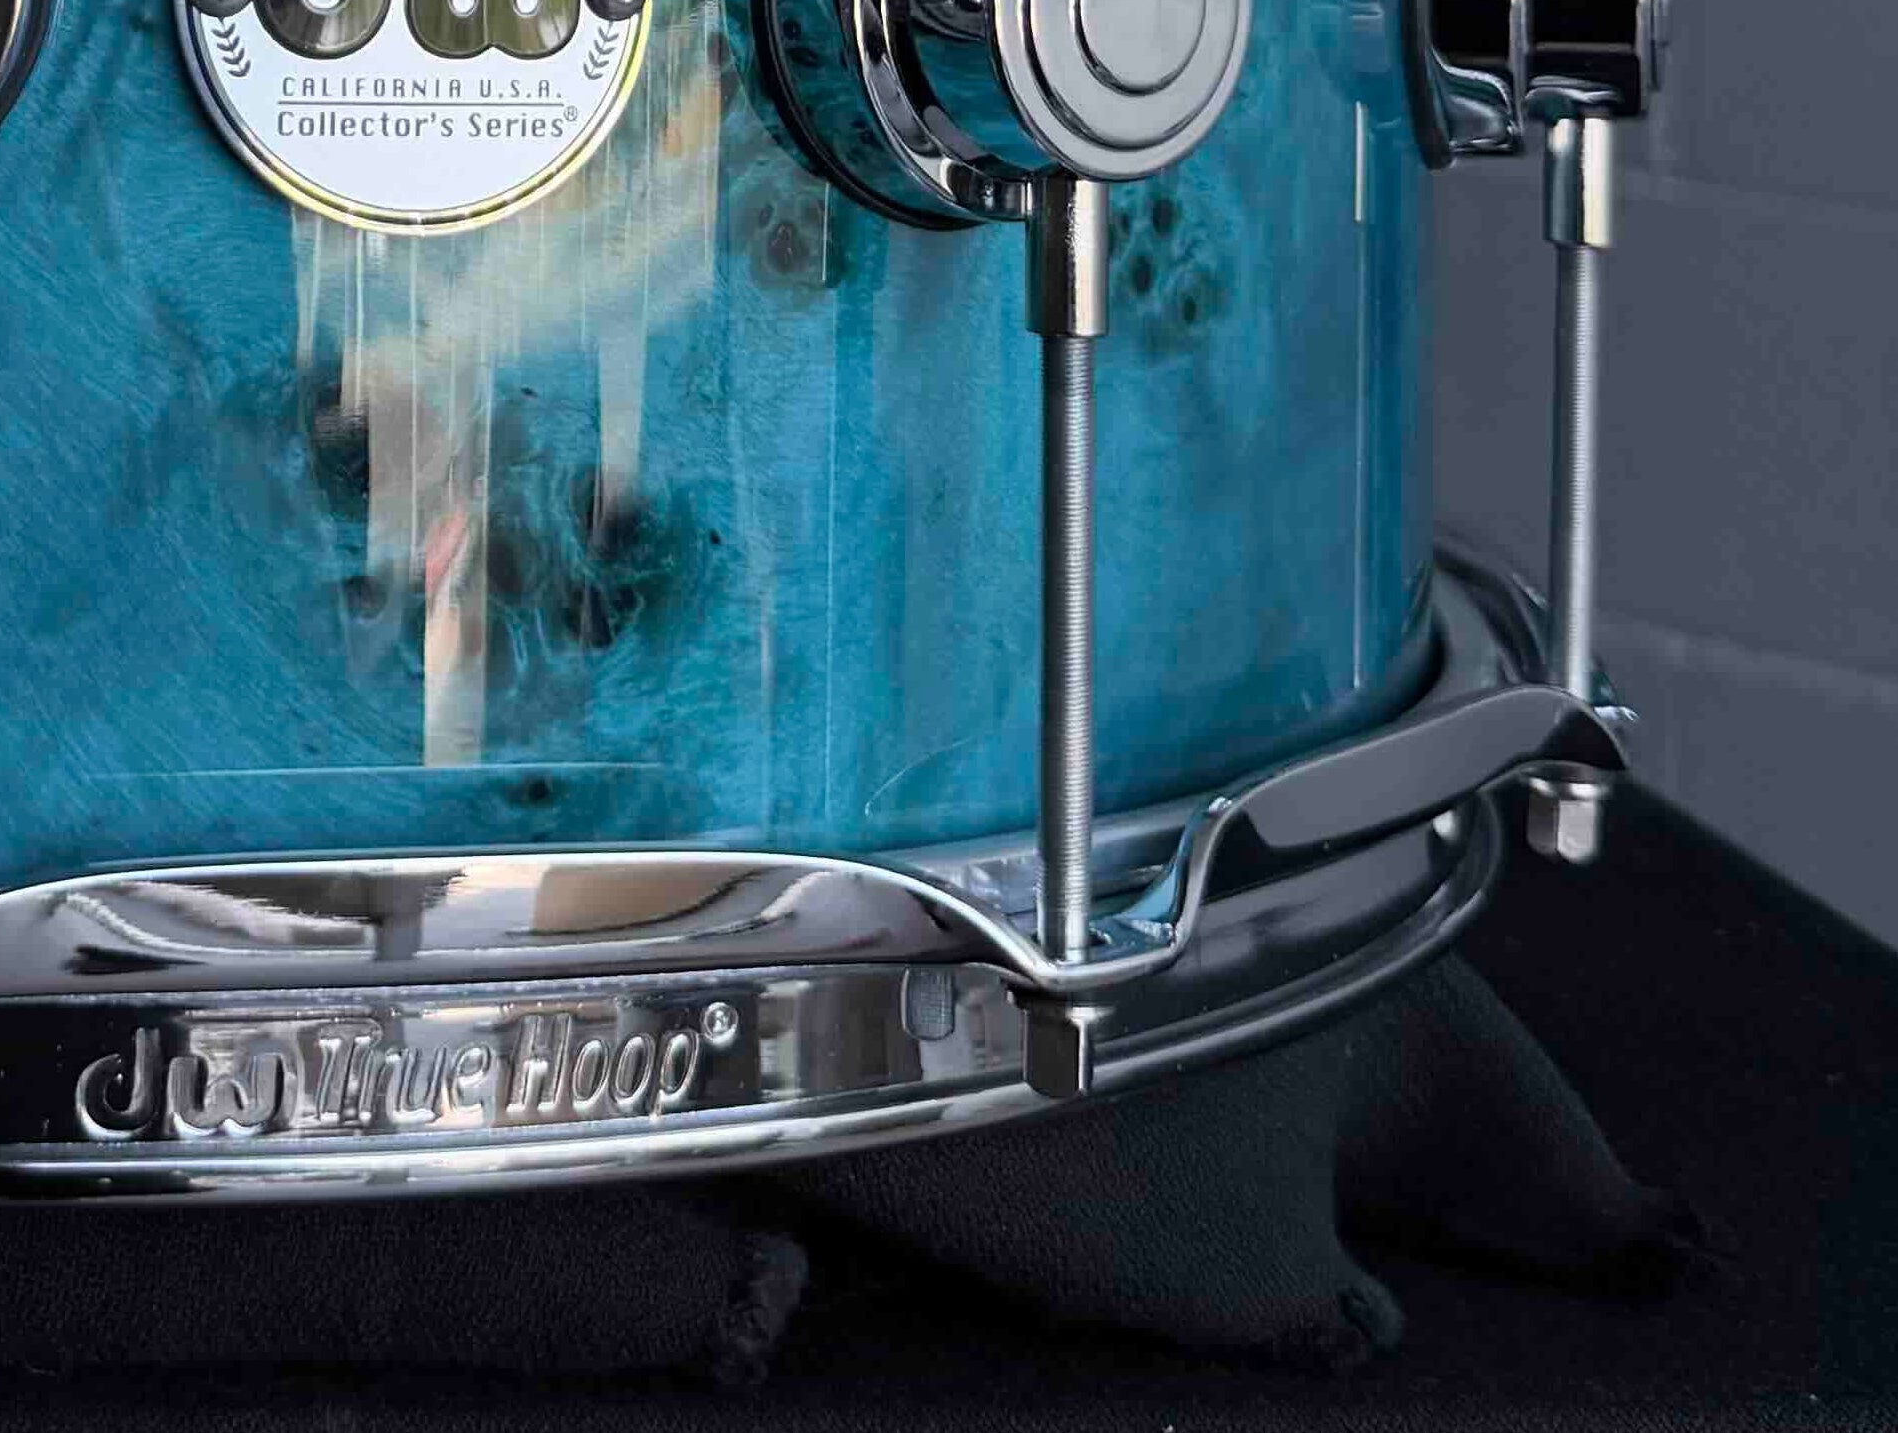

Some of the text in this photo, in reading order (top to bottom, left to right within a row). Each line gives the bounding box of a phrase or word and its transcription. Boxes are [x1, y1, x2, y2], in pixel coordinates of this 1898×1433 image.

[281, 76, 563, 100] CALIFORNIA U.S.A.
[276, 109, 455, 139] Collector's
[315, 1023, 497, 1127] True
